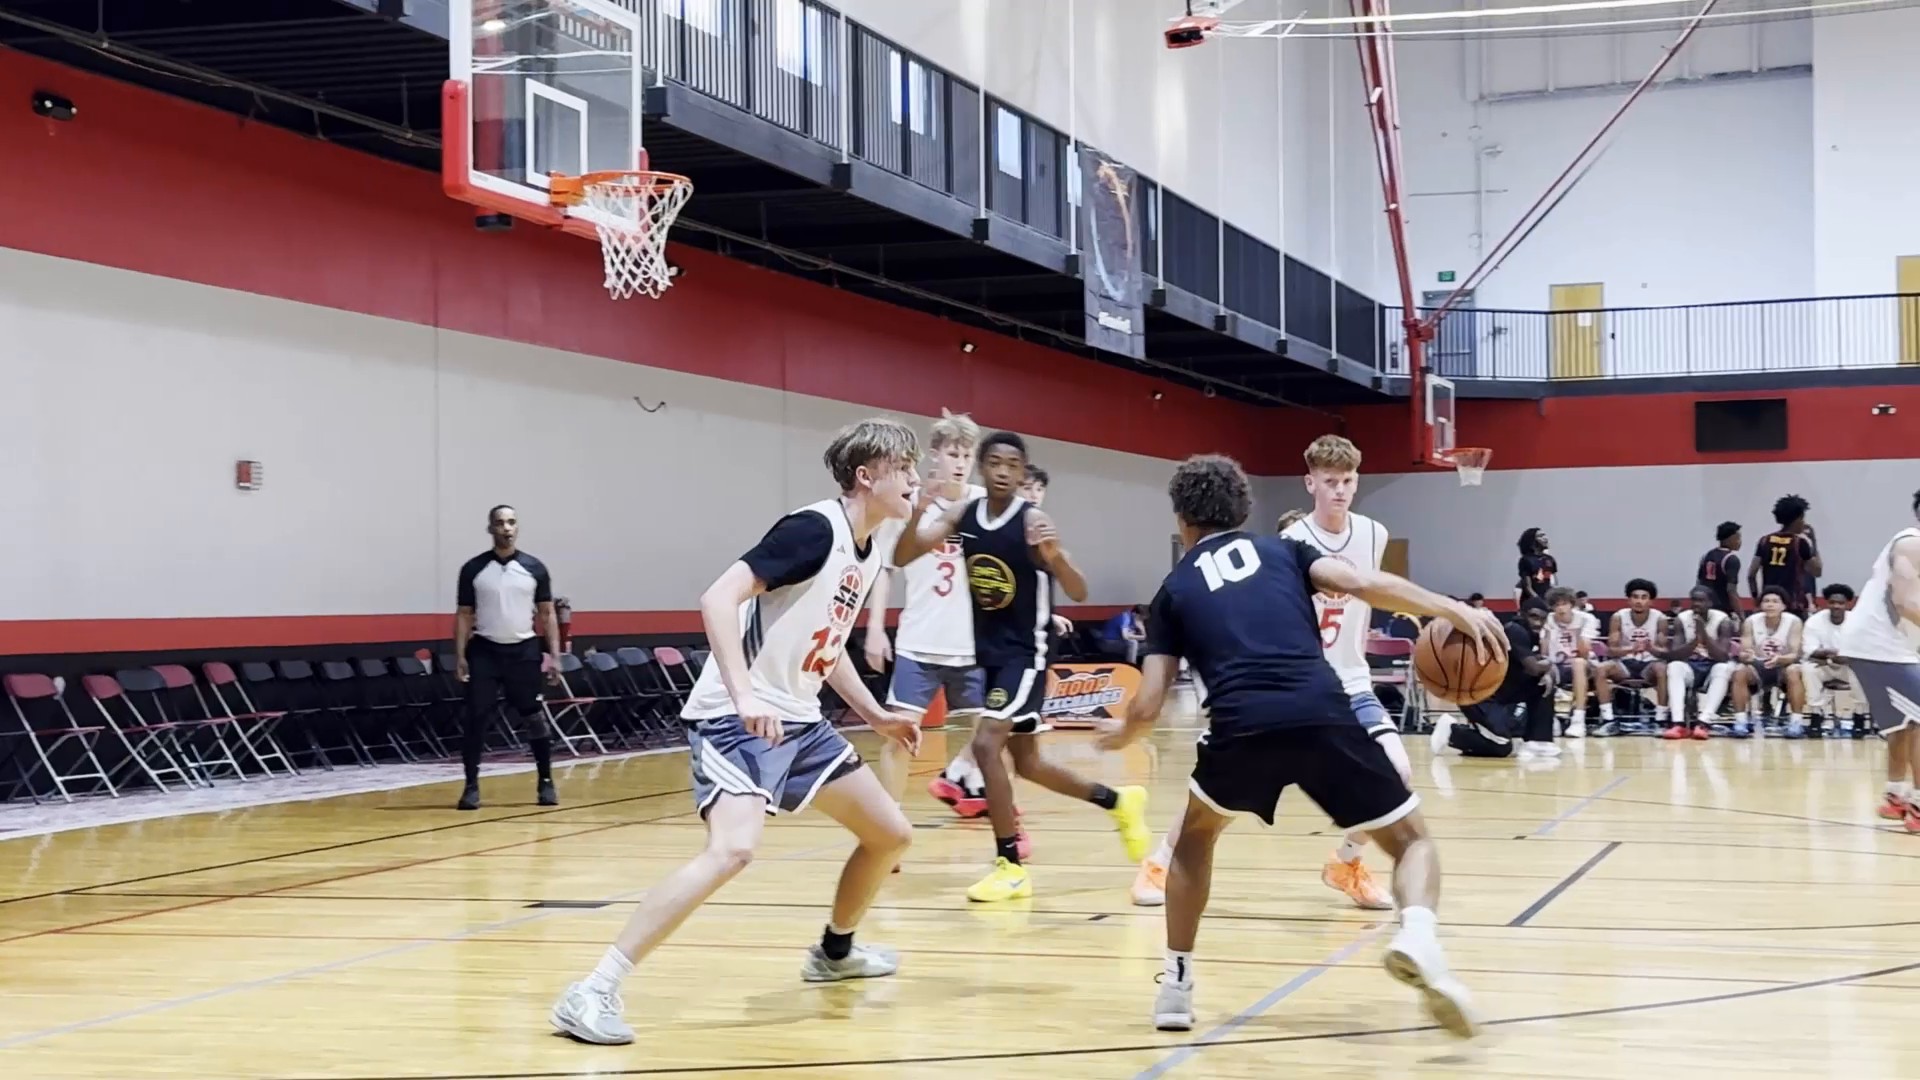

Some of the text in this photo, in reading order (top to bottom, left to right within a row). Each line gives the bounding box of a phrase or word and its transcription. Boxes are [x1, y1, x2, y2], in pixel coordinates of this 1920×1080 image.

[1193, 538, 1262, 592] 10
[1769, 546, 1787, 566] 12
[933, 561, 956, 597] 3
[1319, 608, 1345, 649] 5
[1057, 676, 1110, 697] HOOP
